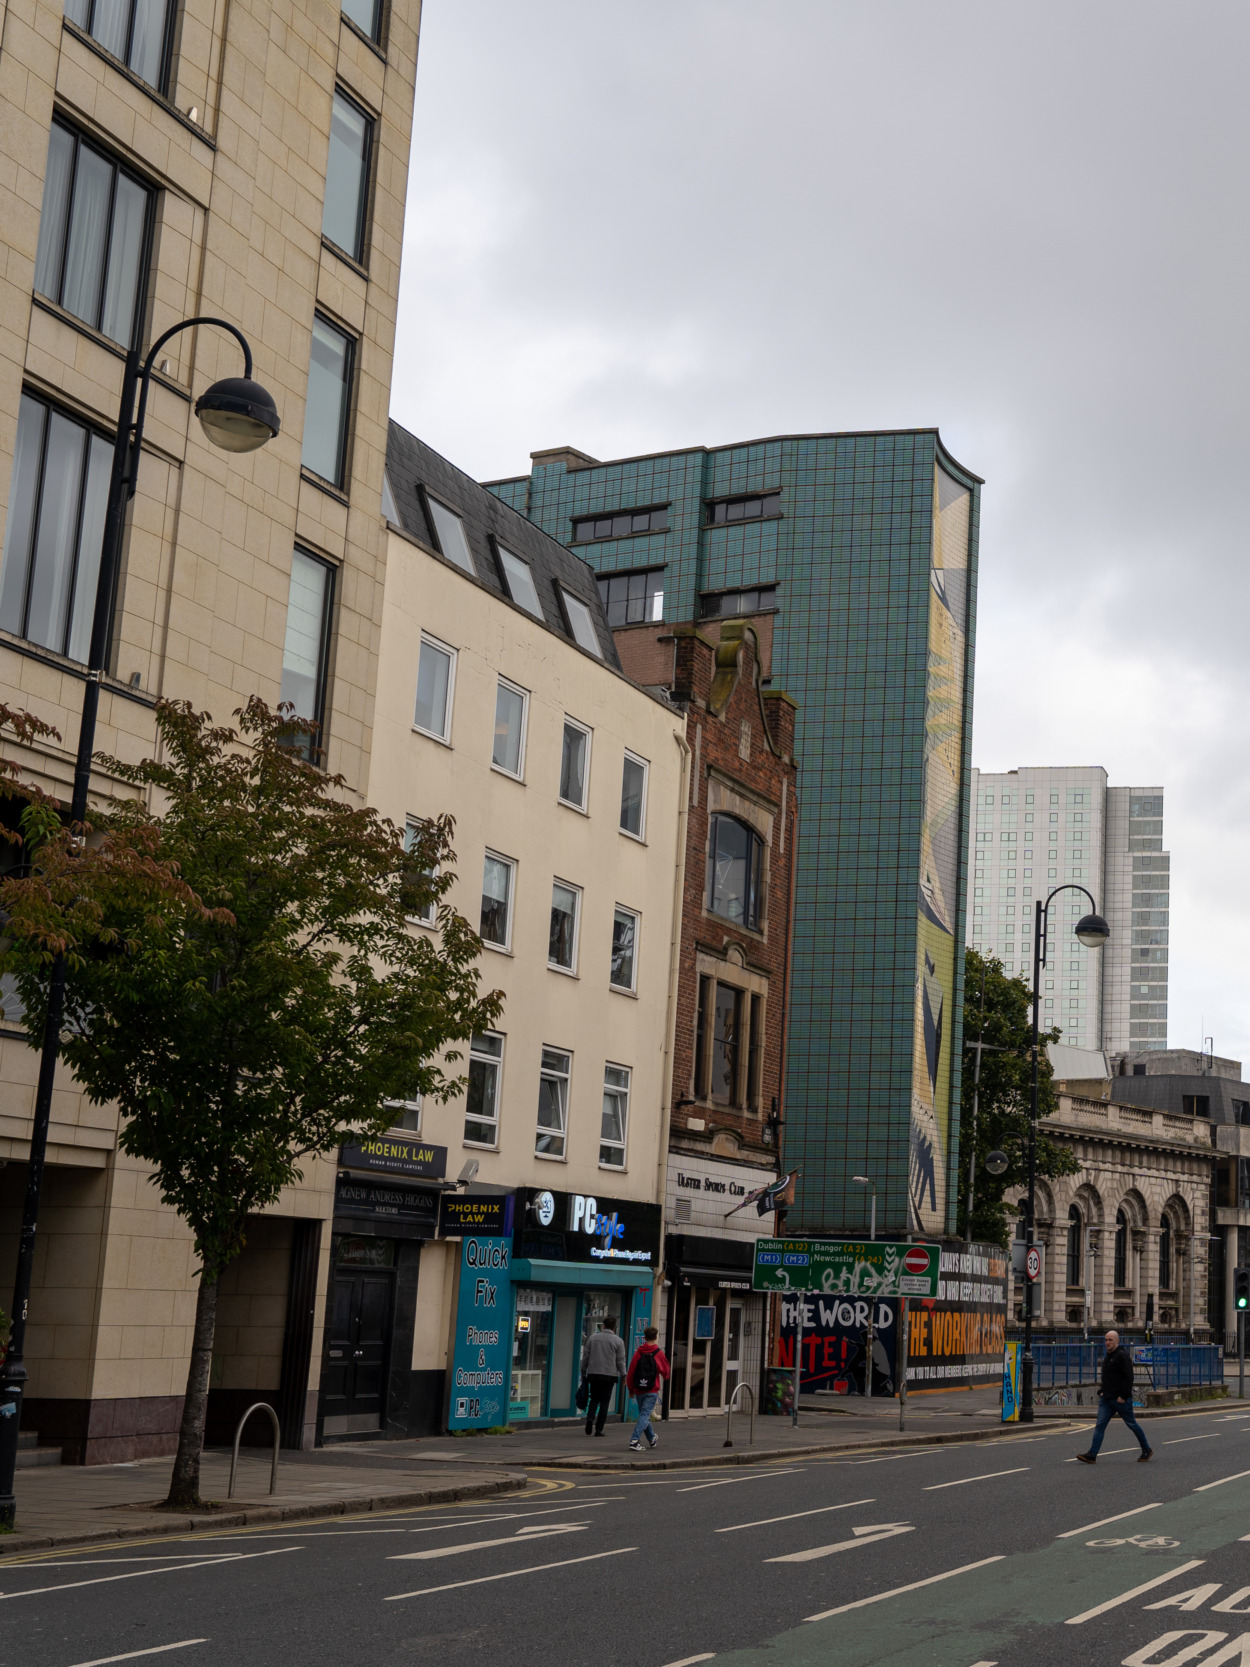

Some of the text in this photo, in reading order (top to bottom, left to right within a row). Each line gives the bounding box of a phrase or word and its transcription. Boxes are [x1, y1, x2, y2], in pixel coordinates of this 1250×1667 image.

[361, 1142, 434, 1163] PHOENIX LAW
[677, 1173, 702, 1190] ULSTER
[729, 1182, 746, 1196] CLUB
[338, 1186, 434, 1208] AGNEW ANDRESS HIGGINS
[447, 1204, 500, 1213] PHOENIX
[460, 1214, 485, 1223] LAW
[569, 1195, 625, 1249] PC Style
[466, 1239, 508, 1269] Quick
[758, 1241, 783, 1250] Dublin
[814, 1243, 842, 1253] Bangor
[759, 1255, 779, 1264] (M1)
[785, 1256, 808, 1266] (M2)
[814, 1254, 854, 1263] Newcastle
[940, 1252, 960, 1272] LWAYS
[1028, 1257, 1039, 1270] 30
[475, 1278, 497, 1307] Fix
[937, 1280, 946, 1300] ND
[946, 1281, 959, 1300] WHO
[781, 1299, 894, 1329] THE WORLD
[467, 1326, 498, 1345] Phones
[902, 1312, 1006, 1356] THE WORKING CLASS
[478, 1348, 485, 1367] &
[456, 1367, 503, 1390] Computers
